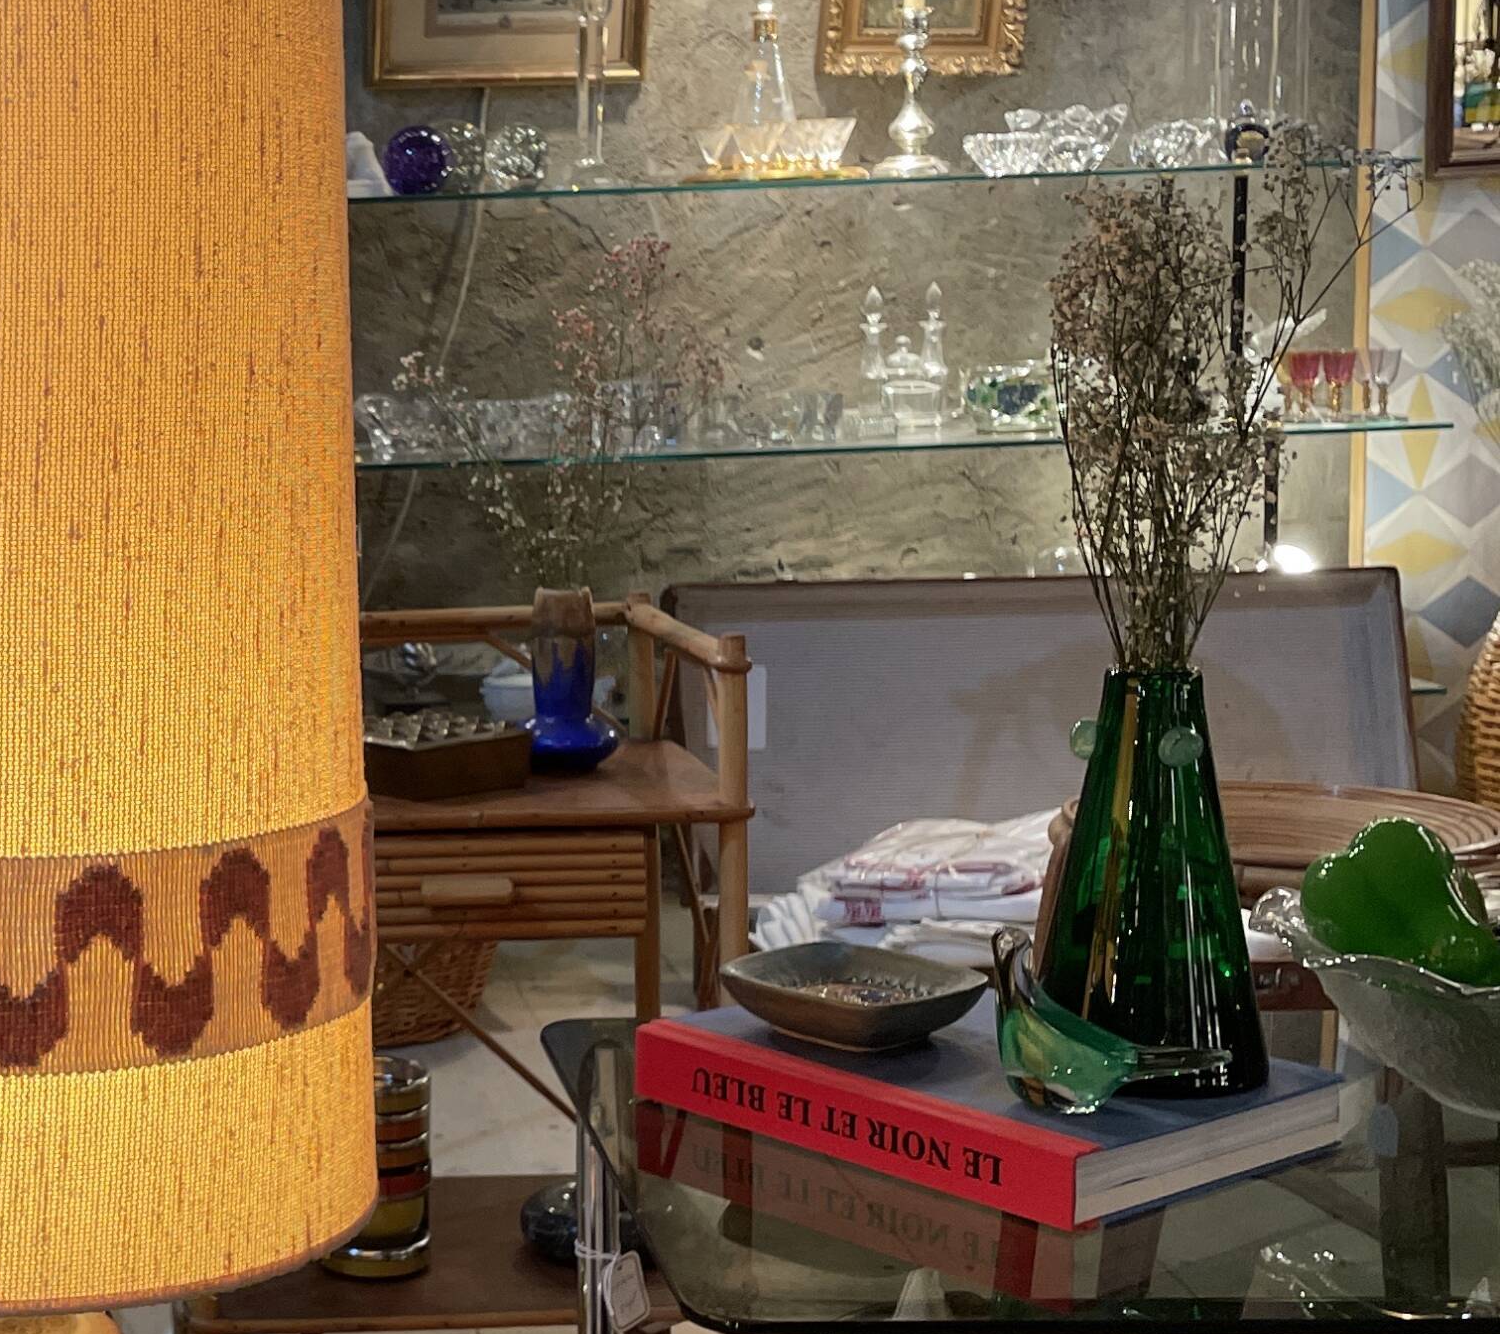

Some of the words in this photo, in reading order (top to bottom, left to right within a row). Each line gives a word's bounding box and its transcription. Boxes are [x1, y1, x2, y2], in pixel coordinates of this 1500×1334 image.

[691, 1067, 766, 1114] BLEU
[776, 1090, 811, 1127] LE
[821, 1105, 858, 1141] ET
[865, 1116, 951, 1171] NOIR
[962, 1146, 1003, 1186] LE
